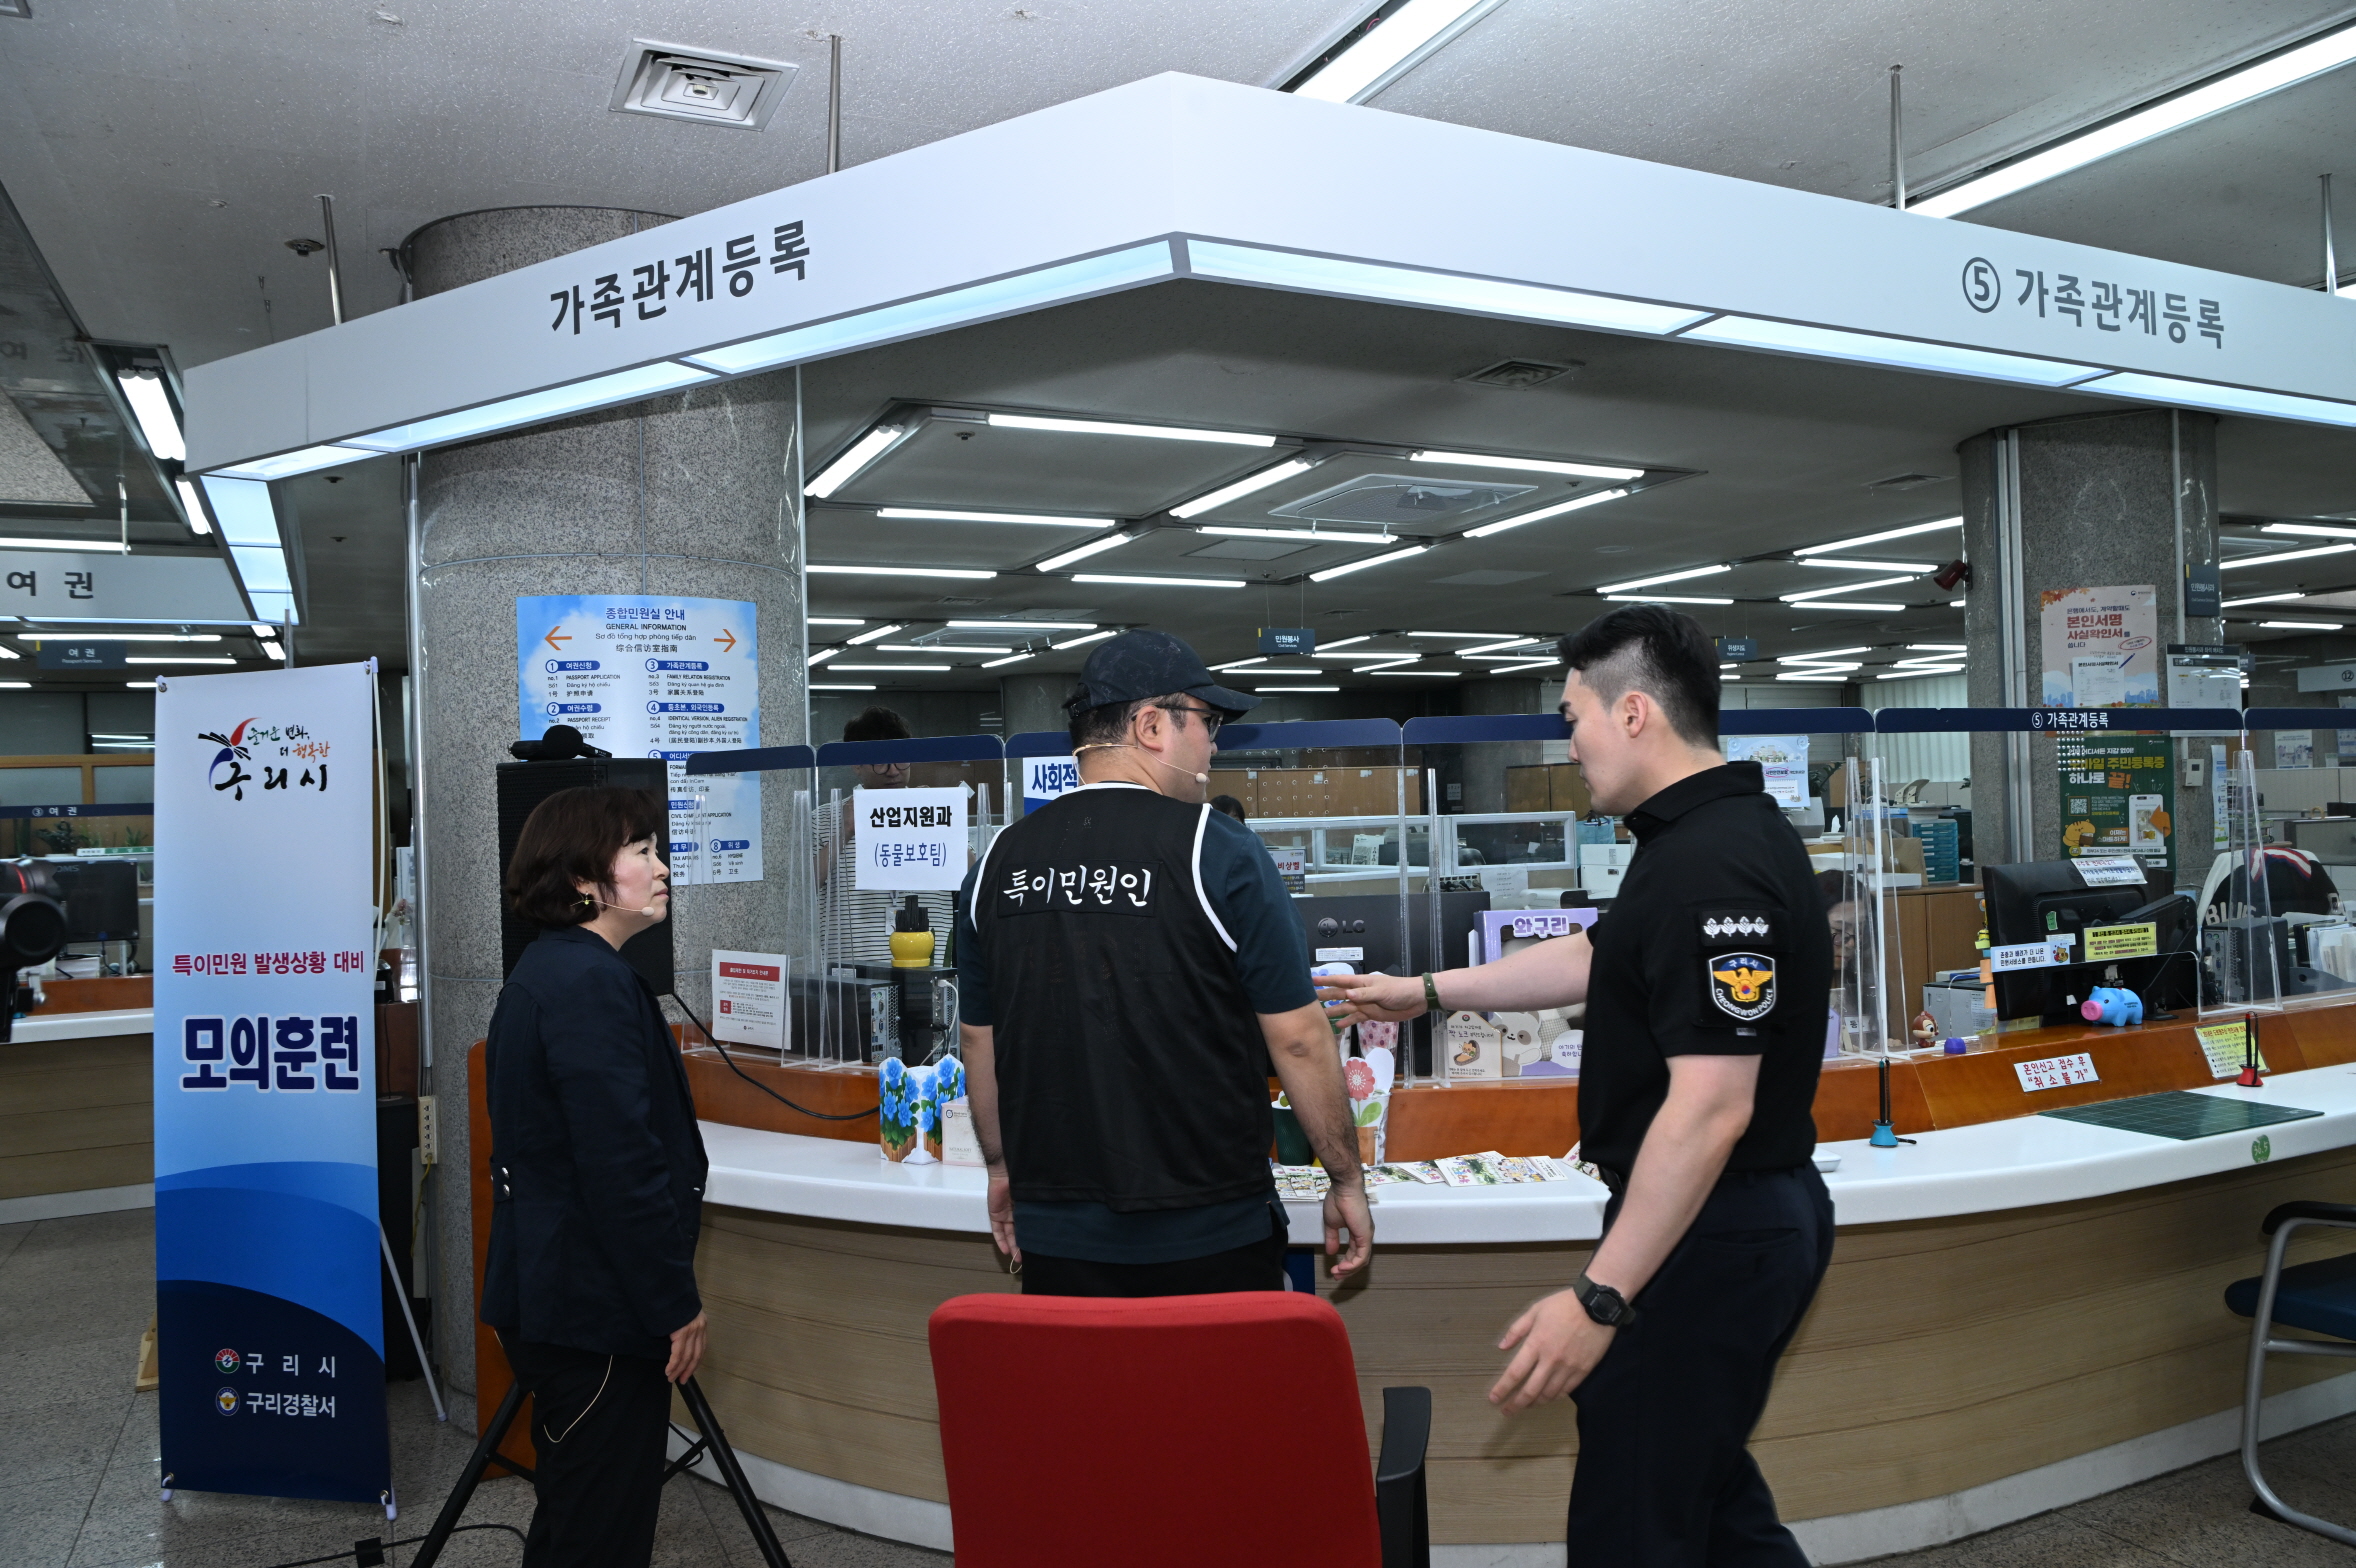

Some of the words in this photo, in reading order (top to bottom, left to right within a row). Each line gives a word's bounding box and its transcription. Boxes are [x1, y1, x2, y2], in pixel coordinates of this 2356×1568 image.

[551, 220, 810, 335] 가족관계등록
[2016, 269, 2224, 349] 가족관계등록
[606, 608, 660, 620] 종합민원실
[665, 609, 685, 620] 안내
[2067, 614, 2122, 628] 본인서명
[2048, 712, 2108, 728] 가족관계등록
[248, 726, 280, 745] 즐거운
[280, 746, 288, 756] 더
[292, 741, 330, 763] 행복한
[2107, 756, 2165, 769] 주민등록증
[1032, 763, 1077, 793] 사회적
[2069, 772, 2105, 784] 하나로
[2108, 772, 2131, 789] 끝!
[870, 806, 952, 827] 산업지원과
[874, 842, 947, 867] (동물보호팀)
[1003, 864, 1151, 907] 특이민원인
[1342, 920, 1365, 934] LG
[1514, 917, 1568, 937] 와구리
[172, 953, 247, 976] 특이민원
[254, 951, 326, 974] 발생상황
[334, 950, 364, 973] 대비
[181, 1014, 360, 1091] 모의훈련
[2023, 1061, 2055, 1075] 혼인신고
[2058, 1058, 2074, 1070] 접수
[2078, 1056, 2086, 1066] 후
[246, 1392, 335, 1418] 구리경찰서
